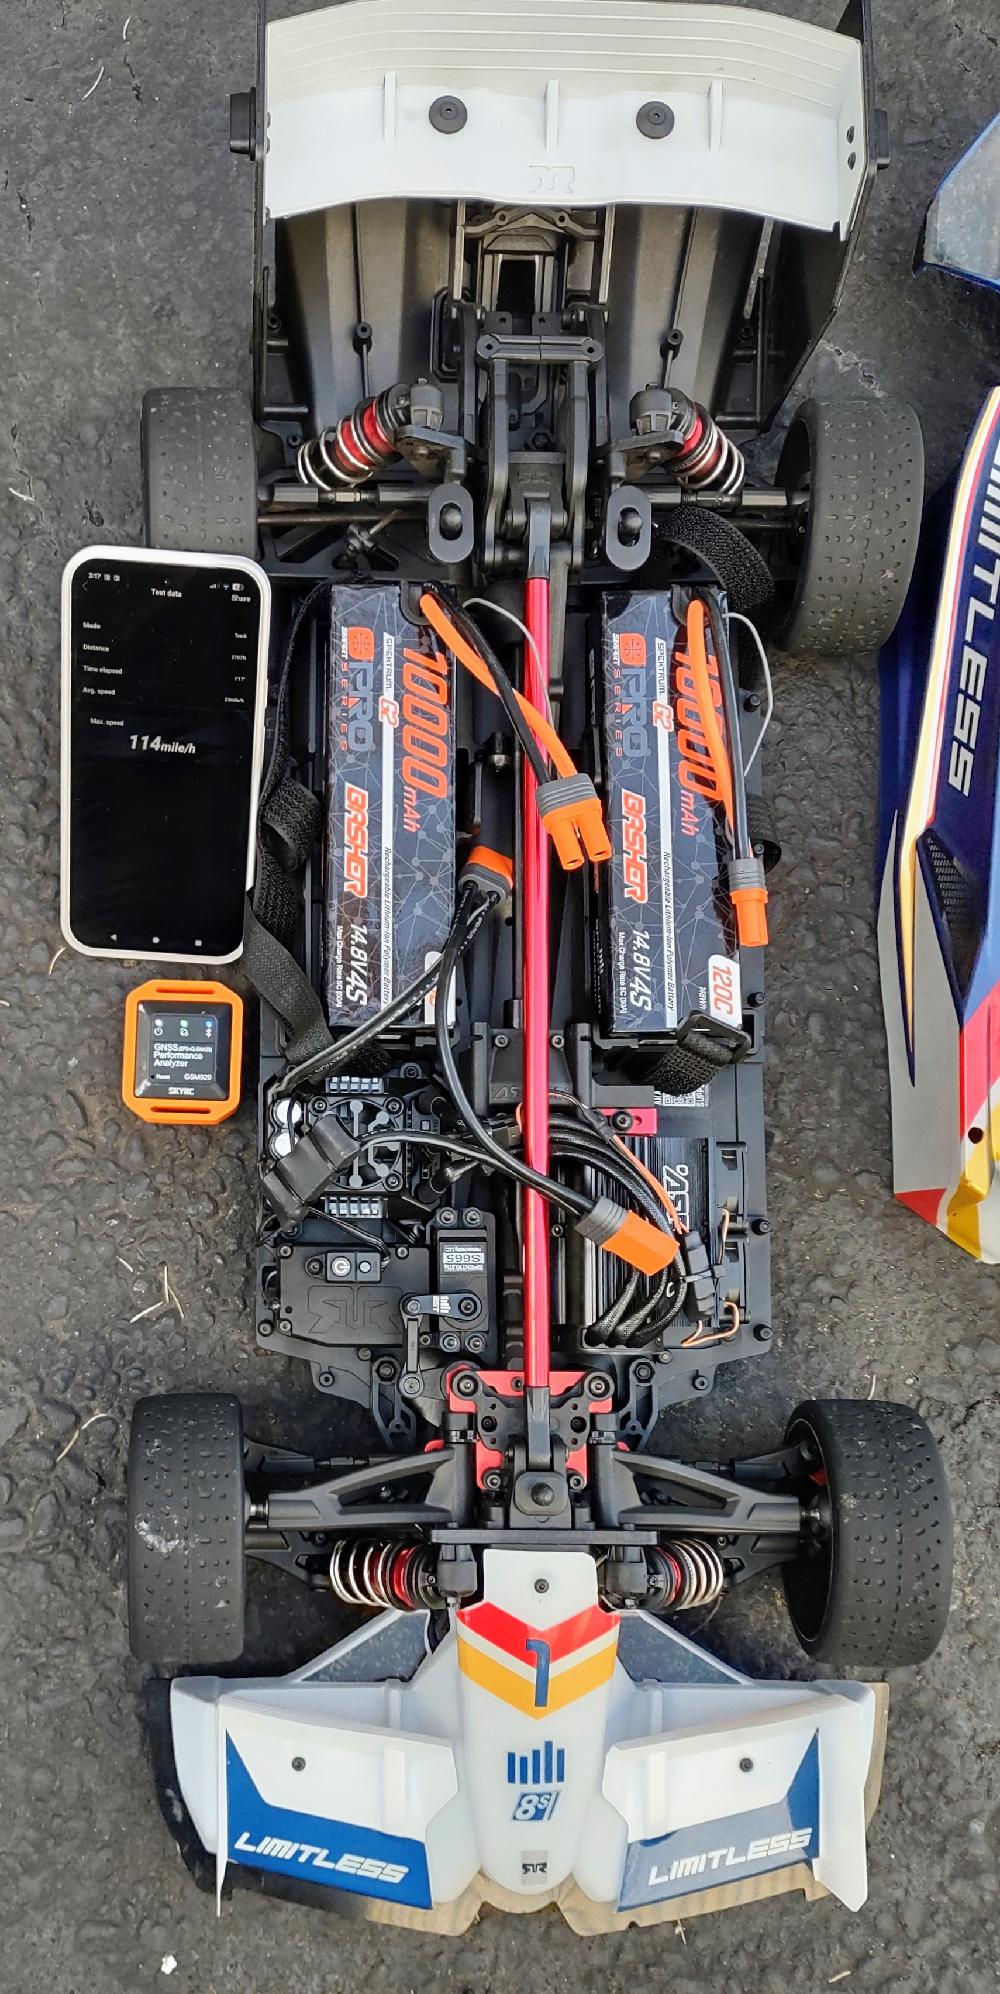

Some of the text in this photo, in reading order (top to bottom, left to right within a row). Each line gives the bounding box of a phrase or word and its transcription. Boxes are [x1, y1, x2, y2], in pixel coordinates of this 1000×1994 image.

[151, 587, 182, 599] Test data
[231, 594, 250, 603] Share
[83, 621, 101, 630] Mode
[83, 643, 110, 652] Distance
[82, 665, 123, 676] Time elapsed
[385, 638, 393, 689] SPEKTRUM
[657, 642, 666, 695] SPEKTRUM
[82, 687, 116, 697] Avg. speed
[348, 661, 374, 751] PRO
[90, 717, 124, 728] Max. speed
[613, 668, 623, 757] SERIES
[621, 668, 649, 758] PRO
[344, 782, 369, 898] BASHER
[622, 788, 648, 904] BASHER
[383, 847, 392, 898] Rechargeable
[662, 851, 672, 903] Rechargeable
[382, 945, 391, 976] Polymer
[665, 949, 674, 981] Polymer
[382, 977, 391, 1006] Battery
[666, 981, 675, 1011] Battery
[712, 965, 734, 1016] 120C
[153, 1043, 179, 1052] GNSS
[153, 1051, 203, 1060] Performance
[153, 1059, 188, 1069] Analyzer
[446, 1254, 481, 1263] S665
[234, 1832, 410, 1884] LIMITLESS
[648, 1827, 813, 1886] LIMITLESS
